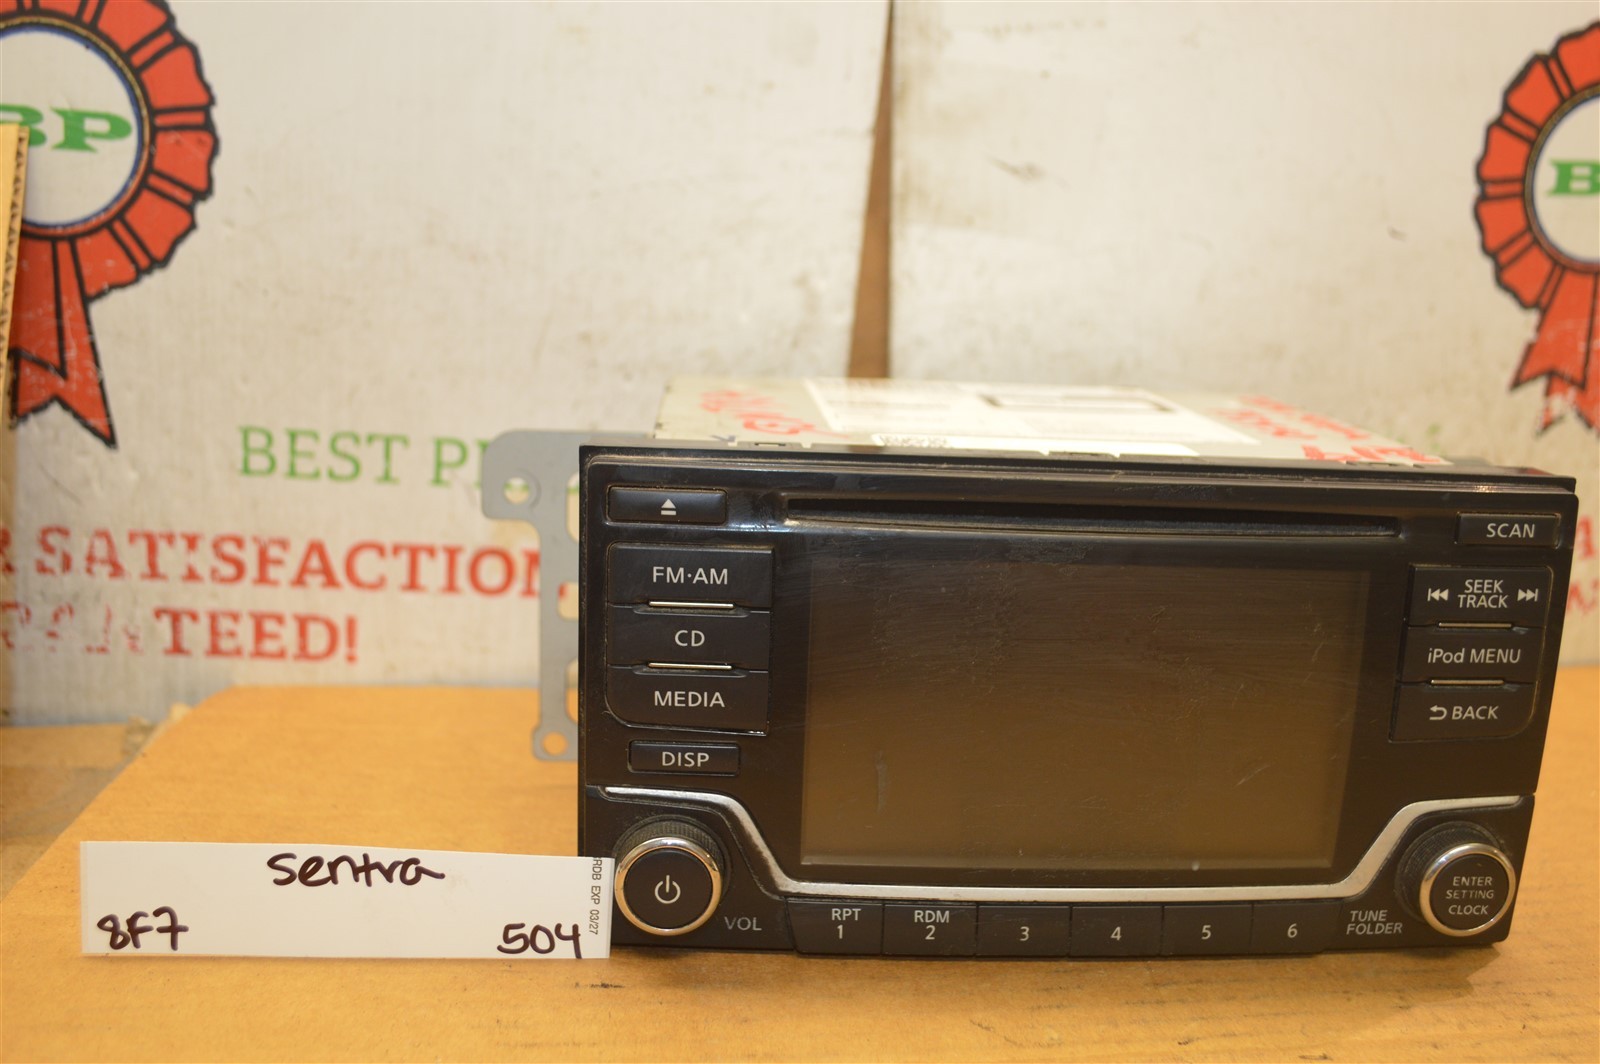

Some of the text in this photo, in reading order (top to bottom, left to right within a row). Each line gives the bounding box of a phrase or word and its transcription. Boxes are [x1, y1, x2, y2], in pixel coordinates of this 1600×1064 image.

[238, 427, 408, 485] BEST
[1486, 523, 1536, 538] SCAN
[1464, 579, 1504, 594] SEEK
[1457, 594, 1508, 609] TRACK
[674, 629, 706, 647] CD
[1427, 648, 1521, 664] iPod MENU
[654, 690, 725, 708] MEDIA
[1451, 705, 1499, 720] BACK
[661, 752, 710, 768] DISP
[1452, 875, 1493, 887] ENTER
[590, 885, 601, 905] EXP
[1445, 889, 1495, 900] SETTING
[831, 908, 861, 921] RPT
[914, 910, 950, 923] RDM
[1349, 910, 1387, 922] TUNE
[1448, 904, 1489, 915] CLOCK
[588, 909, 600, 935] 03/27
[724, 916, 762, 932] VOL
[1346, 922, 1403, 936] FOLDER
[837, 925, 844, 940] 1
[925, 925, 936, 941] 2
[1019, 926, 1030, 942] 3
[1110, 926, 1122, 941] 4
[1201, 925, 1212, 940] 5
[1287, 923, 1298, 939] 6
[496, 922, 583, 960] 504
